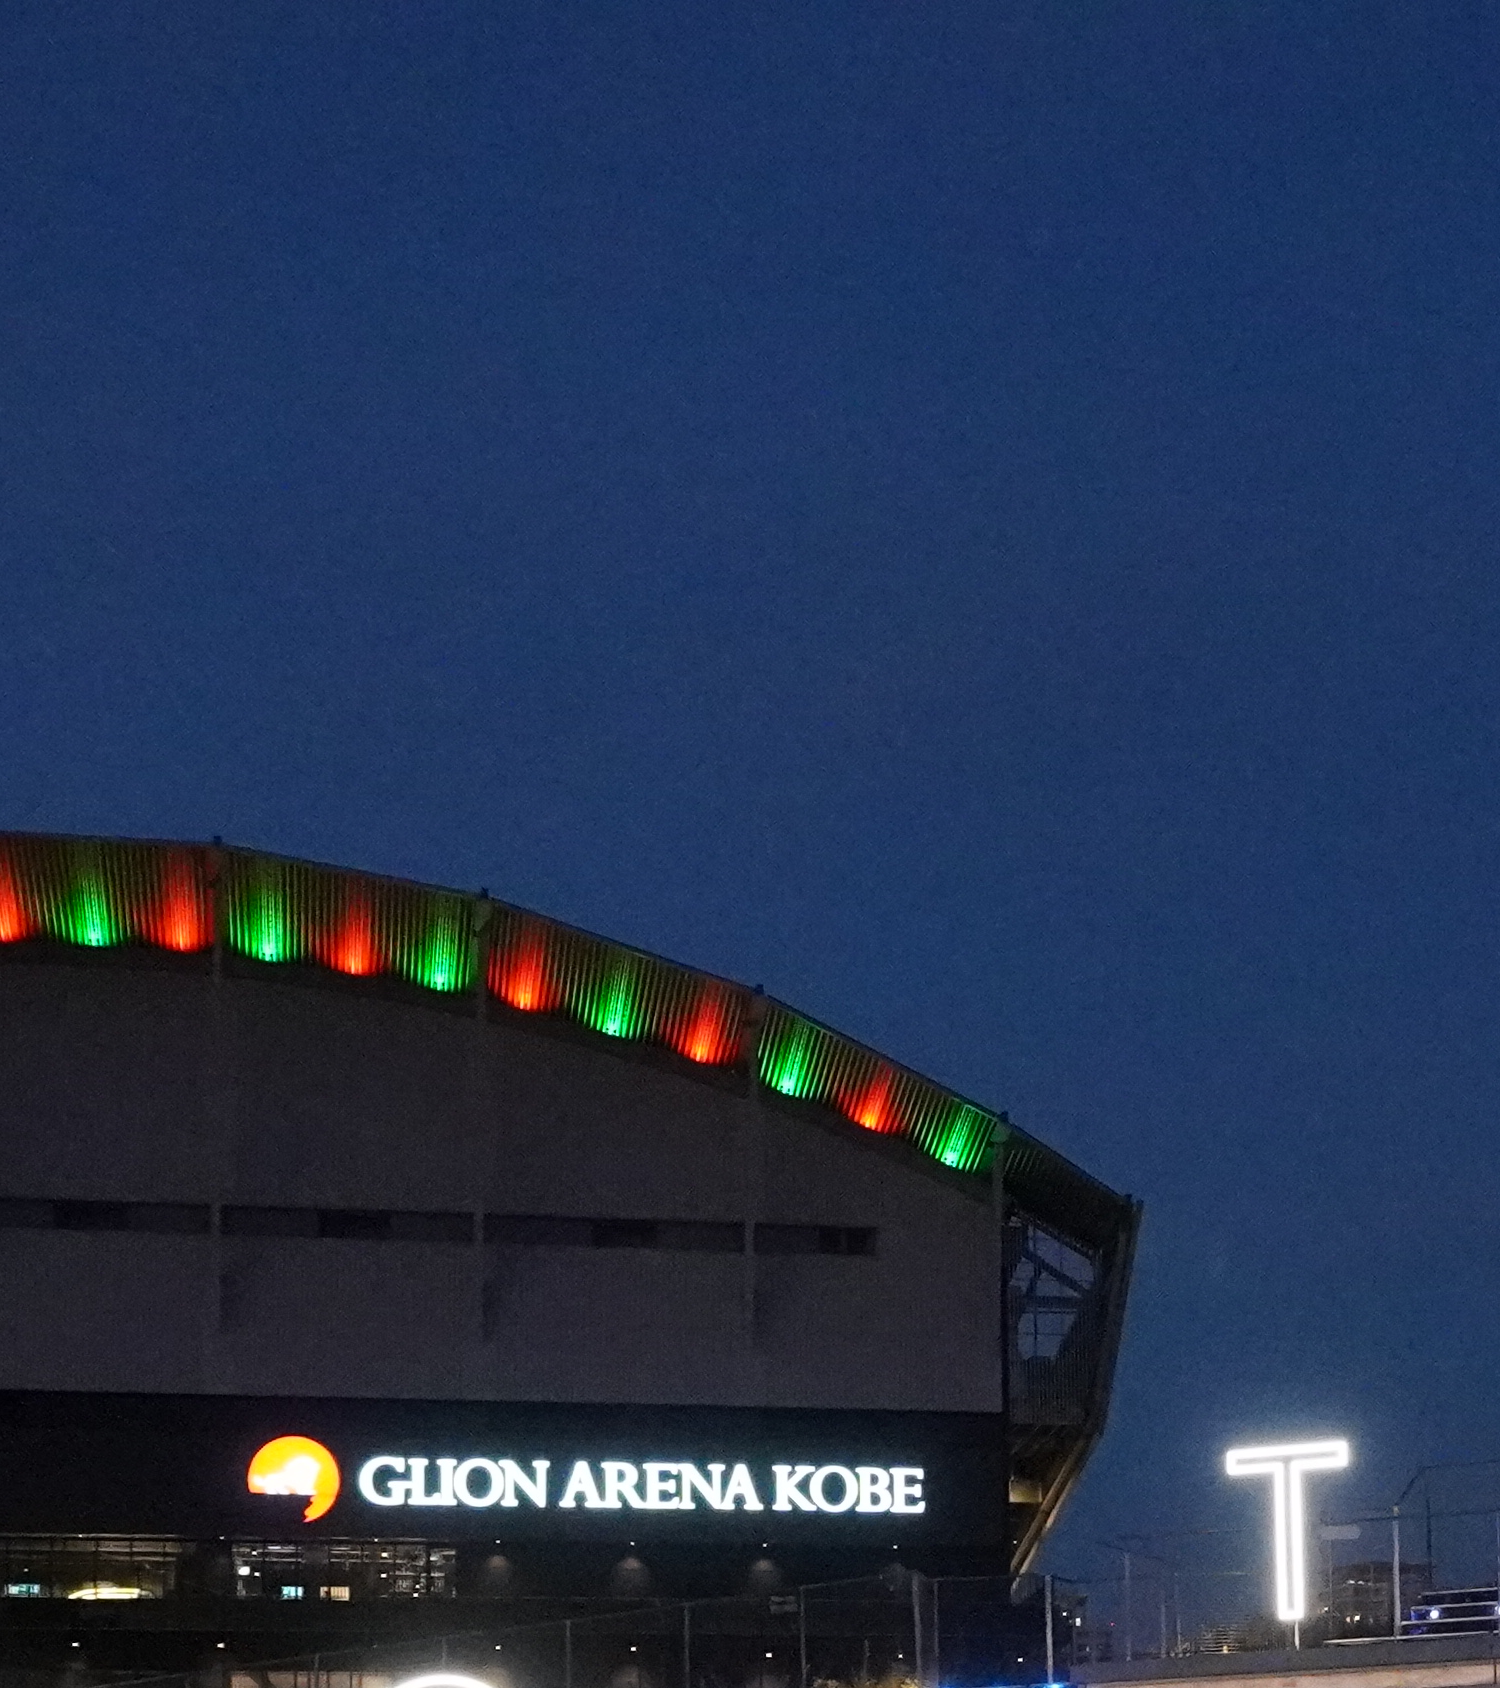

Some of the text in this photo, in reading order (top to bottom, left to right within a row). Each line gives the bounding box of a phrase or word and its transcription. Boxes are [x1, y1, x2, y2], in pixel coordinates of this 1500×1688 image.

[358, 1455, 926, 1514] GLION ARENA KOBE
